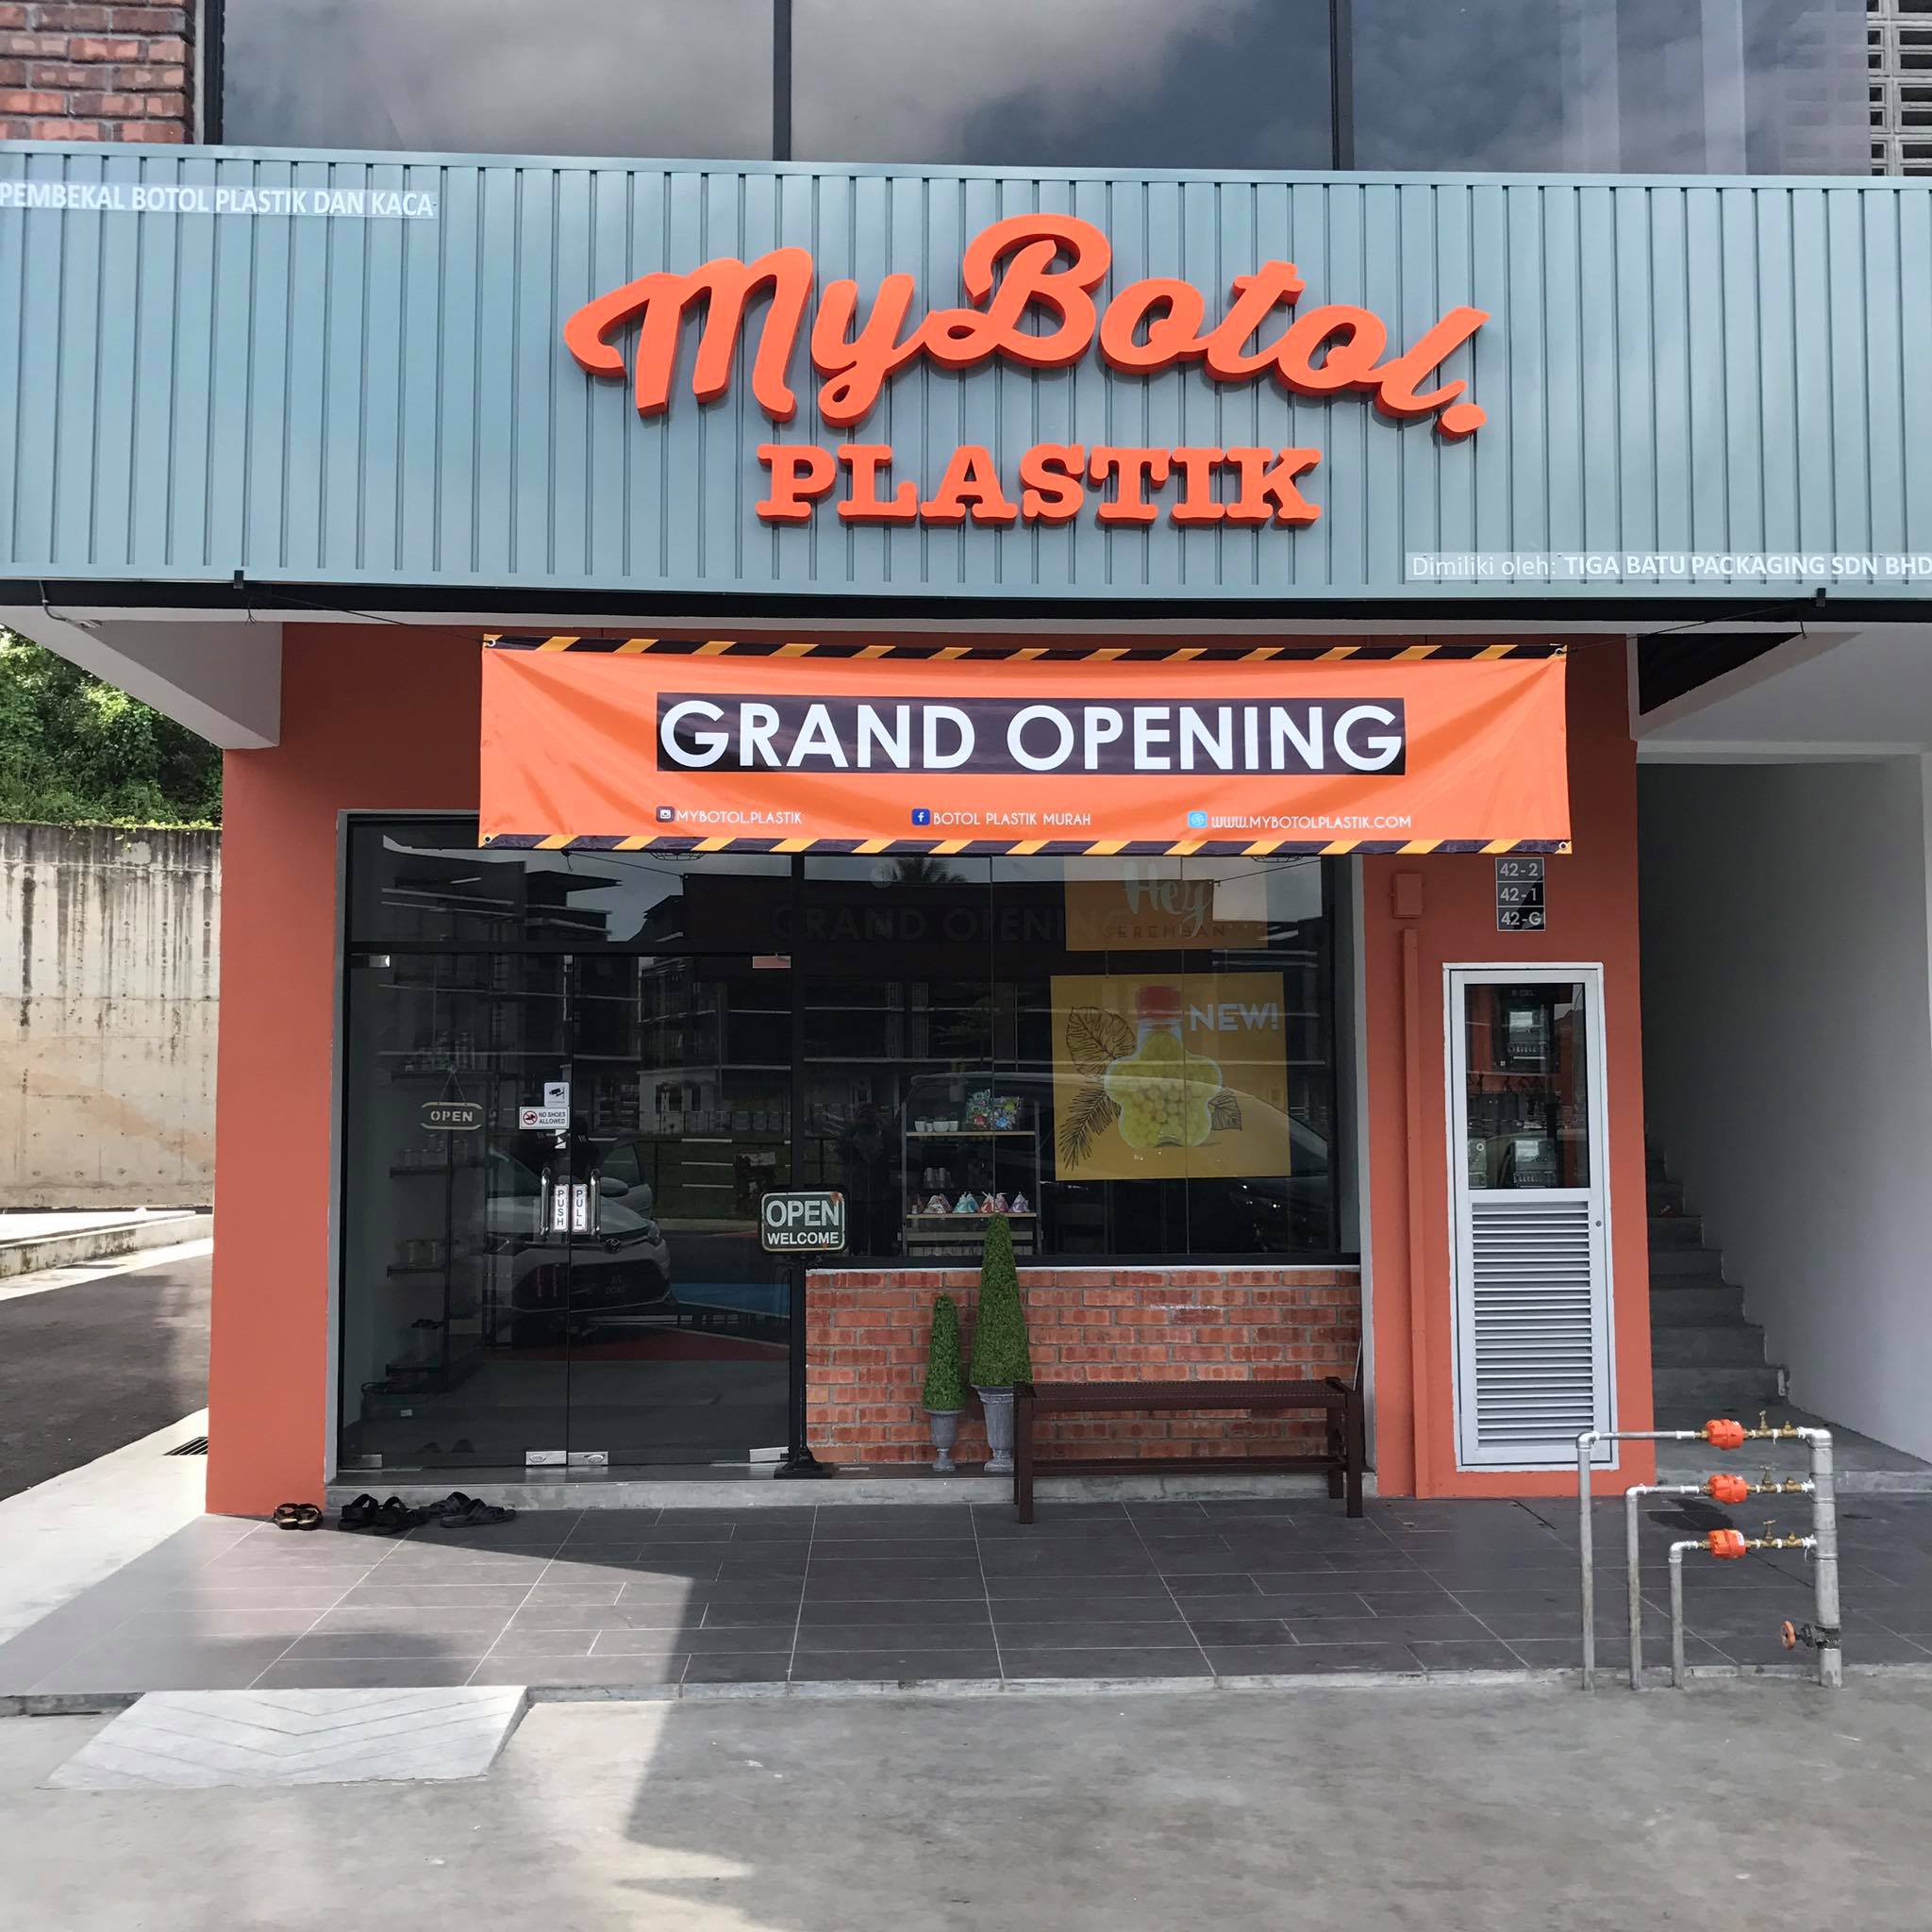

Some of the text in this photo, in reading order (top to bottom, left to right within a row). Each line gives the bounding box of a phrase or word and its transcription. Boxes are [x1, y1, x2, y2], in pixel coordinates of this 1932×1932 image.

[0, 181, 433, 217] PEMBEKAL BOTOL PLASTIK DAN KACA
[756, 443, 1322, 526] PLASTIK
[1413, 555, 1932, 576] Dimiliki oleh: TIGA BATU PACKAGING SDN BHD
[660, 699, 1403, 772] GRAND OPENING
[676, 810, 803, 825] MYBOTOL.PLASTIK
[933, 812, 1091, 826] BOTOL PLASTIK MURAH
[1499, 862, 1539, 876] 42-2
[1499, 887, 1537, 902] 42-1
[1500, 911, 1541, 925] 42-G
[1191, 1002, 1279, 1031] NEW!
[430, 1110, 474, 1122] OPEN
[557, 1190, 565, 1226] PUSH
[766, 1200, 840, 1227] OPEN
[767, 1231, 840, 1245] WELCOME
